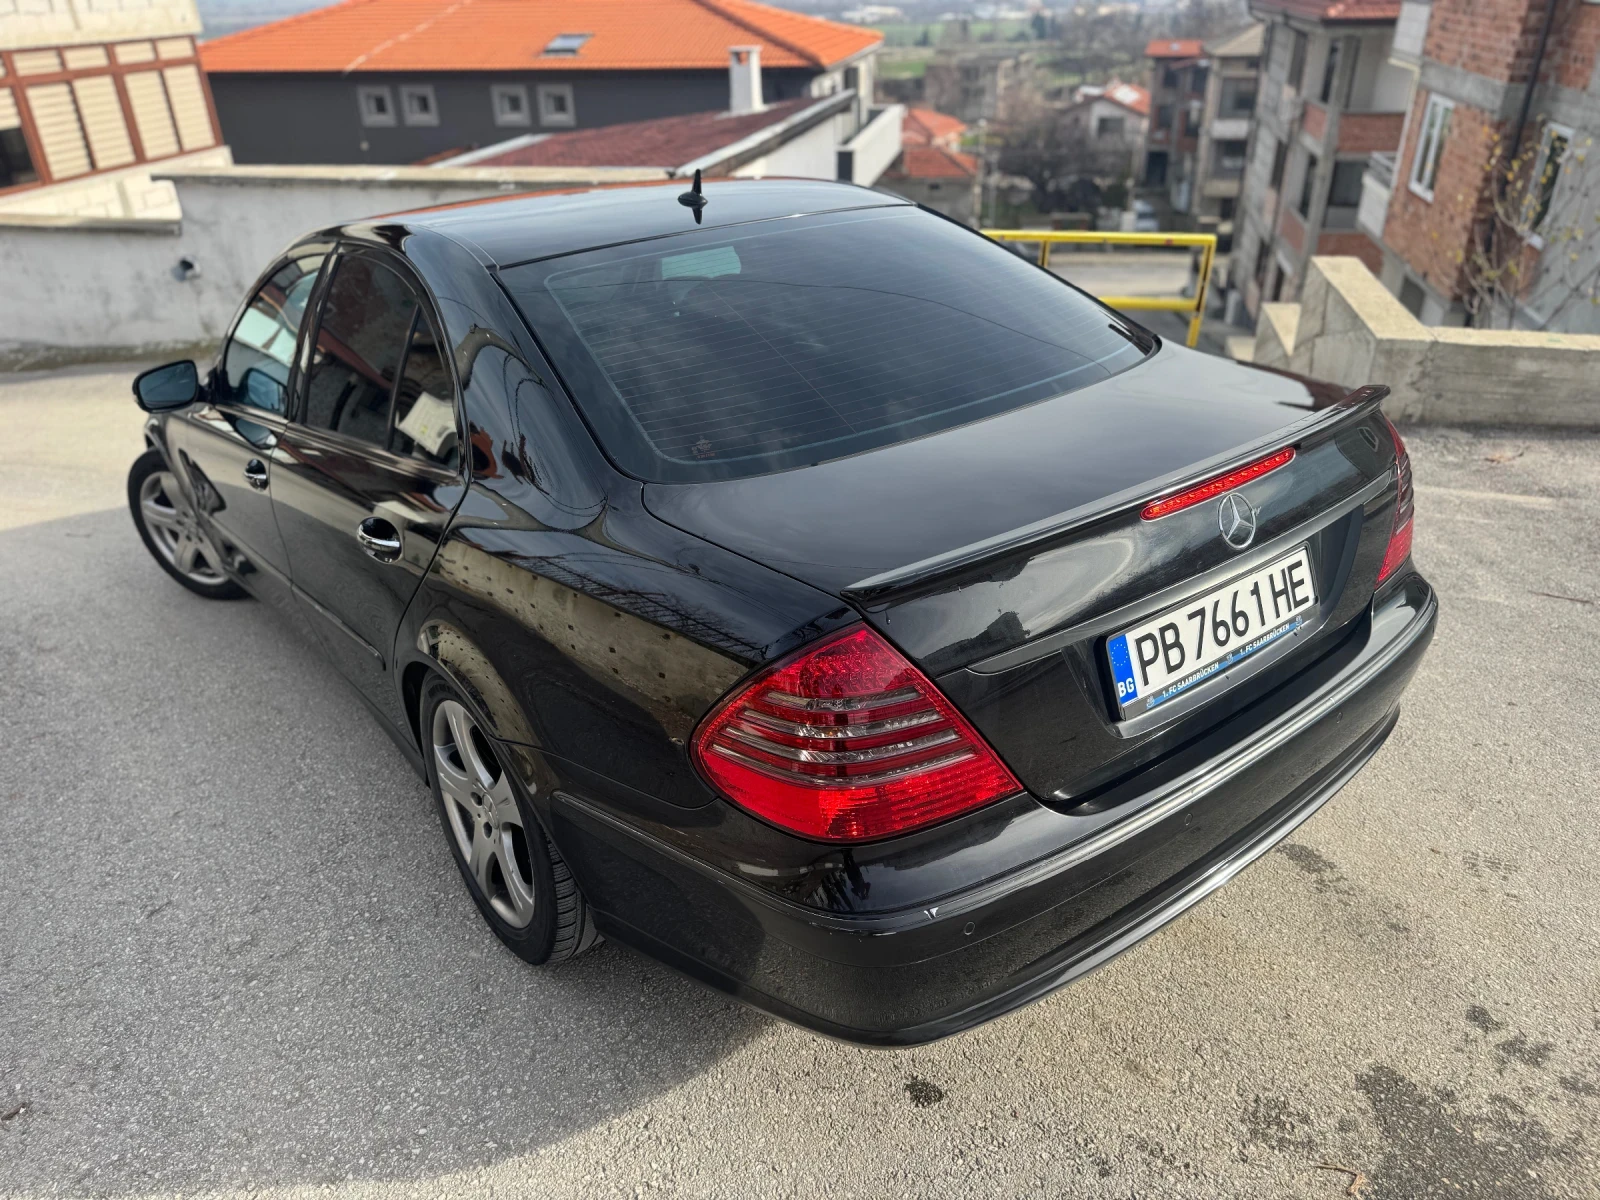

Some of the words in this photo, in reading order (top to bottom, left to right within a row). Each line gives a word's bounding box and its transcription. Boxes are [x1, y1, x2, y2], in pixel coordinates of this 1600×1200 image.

[1135, 622, 1186, 687] PB
[1187, 581, 1267, 661] 7661
[1269, 559, 1310, 619] HE
[1245, 643, 1253, 653] FC
[1252, 622, 1290, 649] SAARBRÜCKEN
[1117, 677, 1136, 697] BG
[1168, 684, 1177, 694] FC
[1177, 661, 1219, 690] SAARBRÜCKEN
